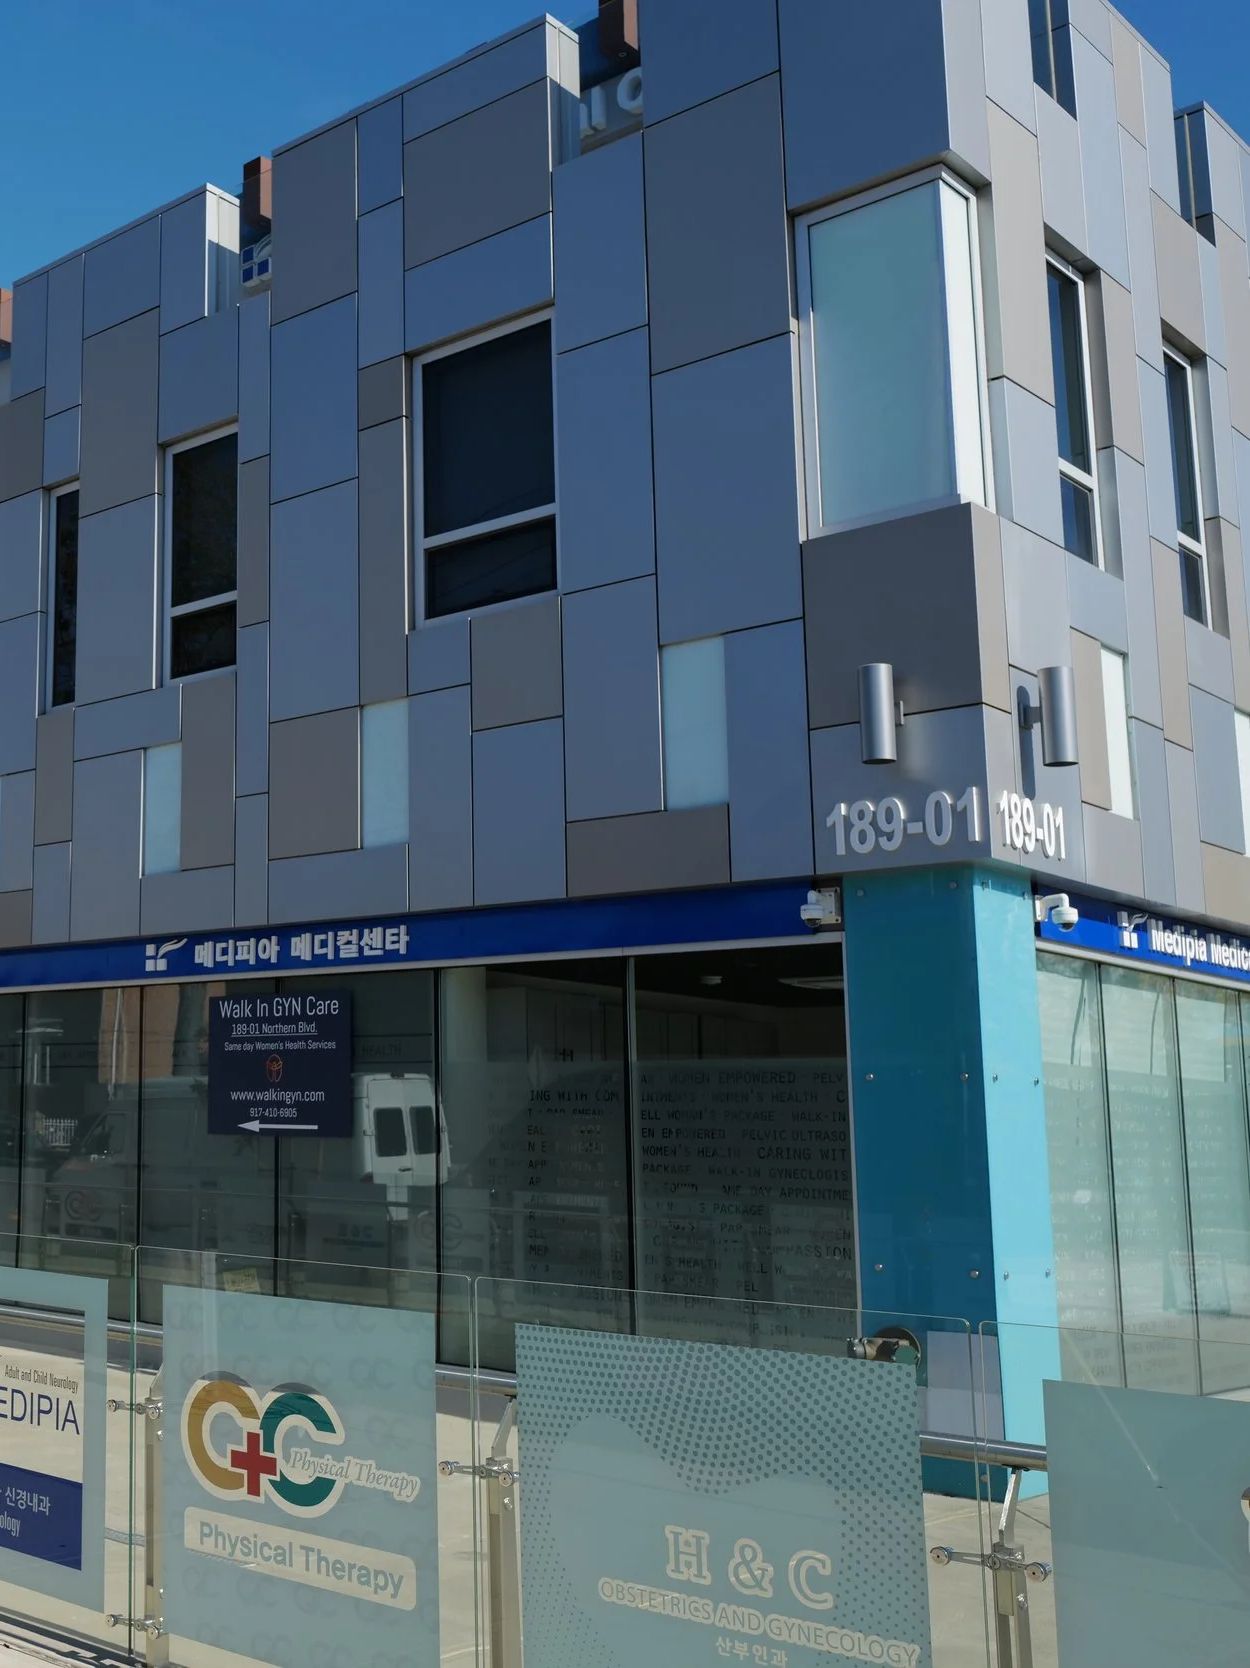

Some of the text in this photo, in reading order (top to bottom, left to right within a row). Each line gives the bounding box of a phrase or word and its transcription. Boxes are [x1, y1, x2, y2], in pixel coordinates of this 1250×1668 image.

[826, 786, 981, 856] 189-01
[999, 789, 1066, 861] 189-01
[194, 924, 410, 968] 메디피아 메디컬센터
[1147, 919, 1207, 966] Medipia
[219, 996, 339, 1019] Walk In GYN Care
[224, 1040, 336, 1052] Same day Women's Health Services
[231, 1021, 318, 1035] 189-01 Northern Blvd.
[231, 1088, 325, 1104] www.walkingyn.com
[250, 1108, 298, 1118] 917-410-6905
[5, 1365, 79, 1394] Adult and Child Neurology
[290, 1450, 419, 1499] Physical Therapy
[4, 1486, 51, 1516] 신경내과
[199, 1520, 405, 1599] Physical Therapy
[665, 1524, 834, 1610] H & C
[598, 1577, 921, 1668] OBSTETRICS AND GYNECOLOGY
[715, 1635, 789, 1668] 산부인과
